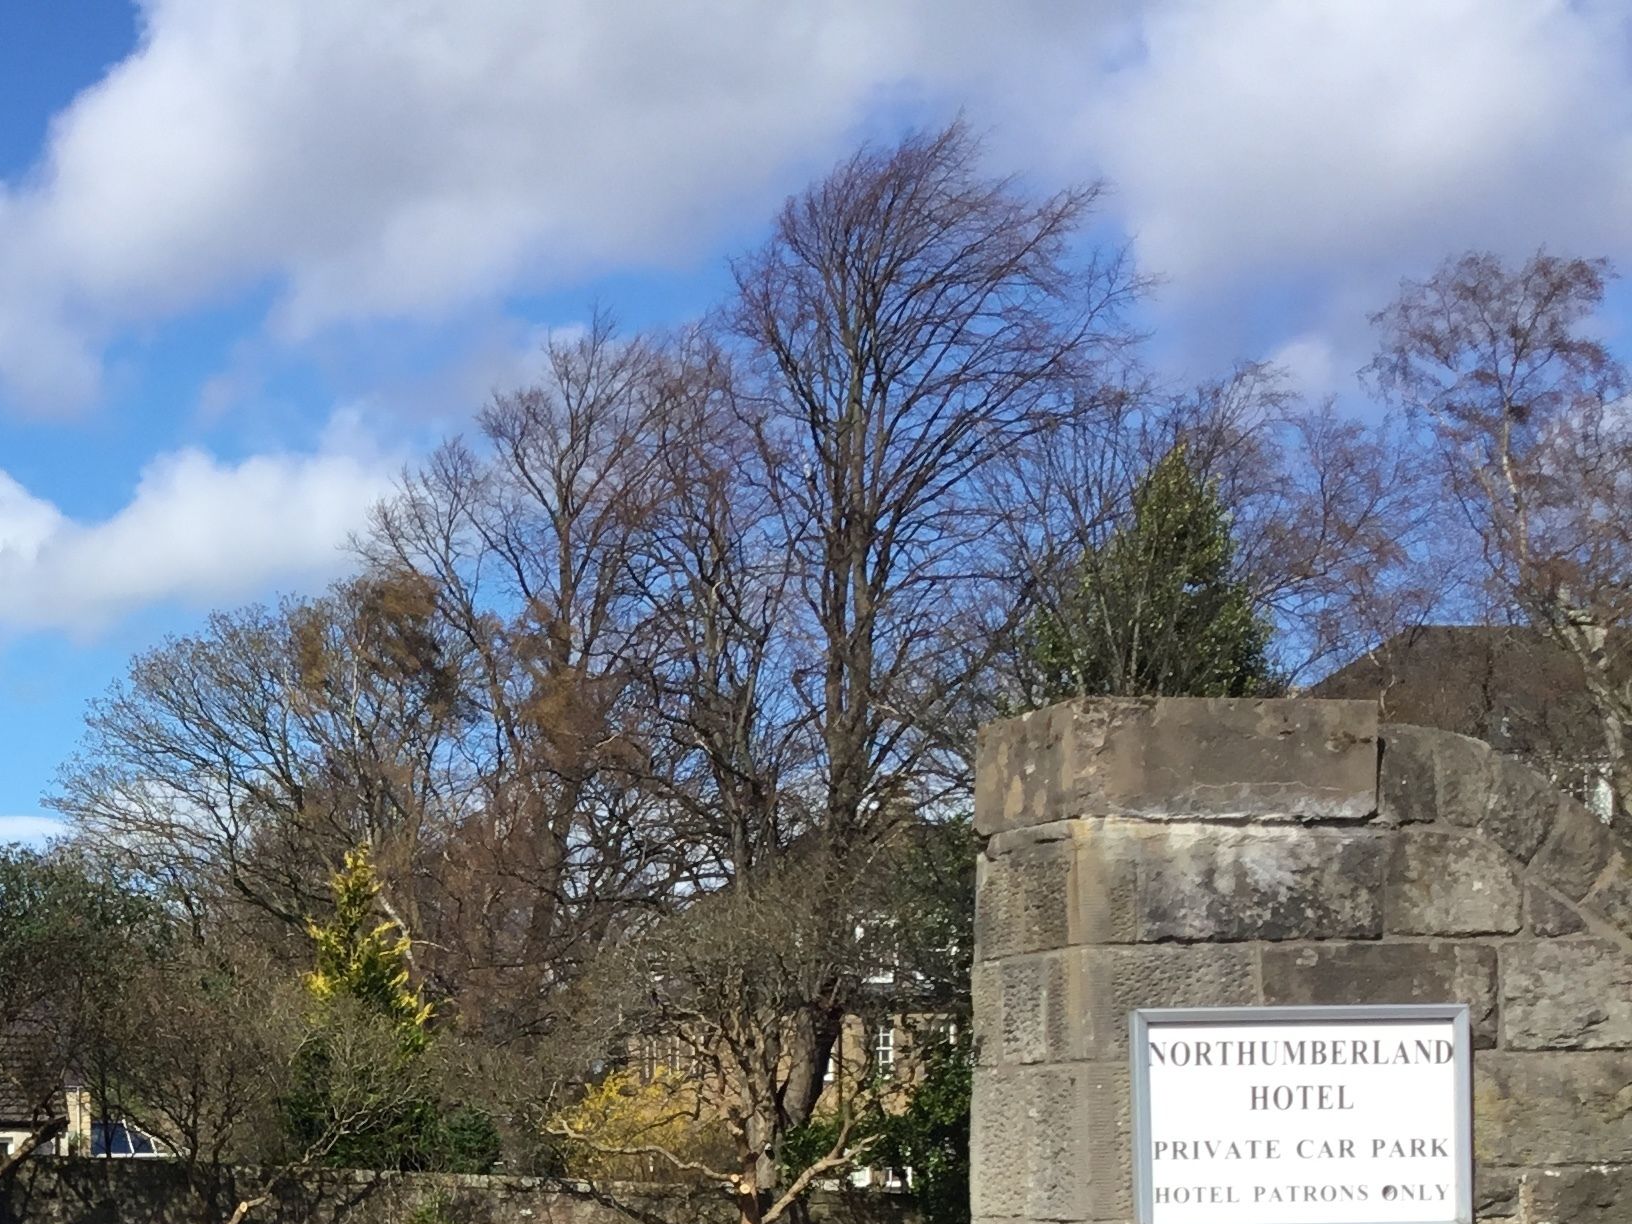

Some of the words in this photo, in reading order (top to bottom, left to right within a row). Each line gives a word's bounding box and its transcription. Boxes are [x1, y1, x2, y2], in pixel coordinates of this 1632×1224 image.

[1148, 1039, 1455, 1067] NORTHUMBERLAND
[1249, 1085, 1355, 1111] HOTEL
[1154, 1140, 1282, 1160] PRIVATE
[1296, 1139, 1356, 1159] CAR
[1371, 1138, 1449, 1158] PARK
[1155, 1186, 1240, 1204] HOTEL
[1253, 1185, 1369, 1202] PATRONS
[1381, 1184, 1450, 1201] ONLY
